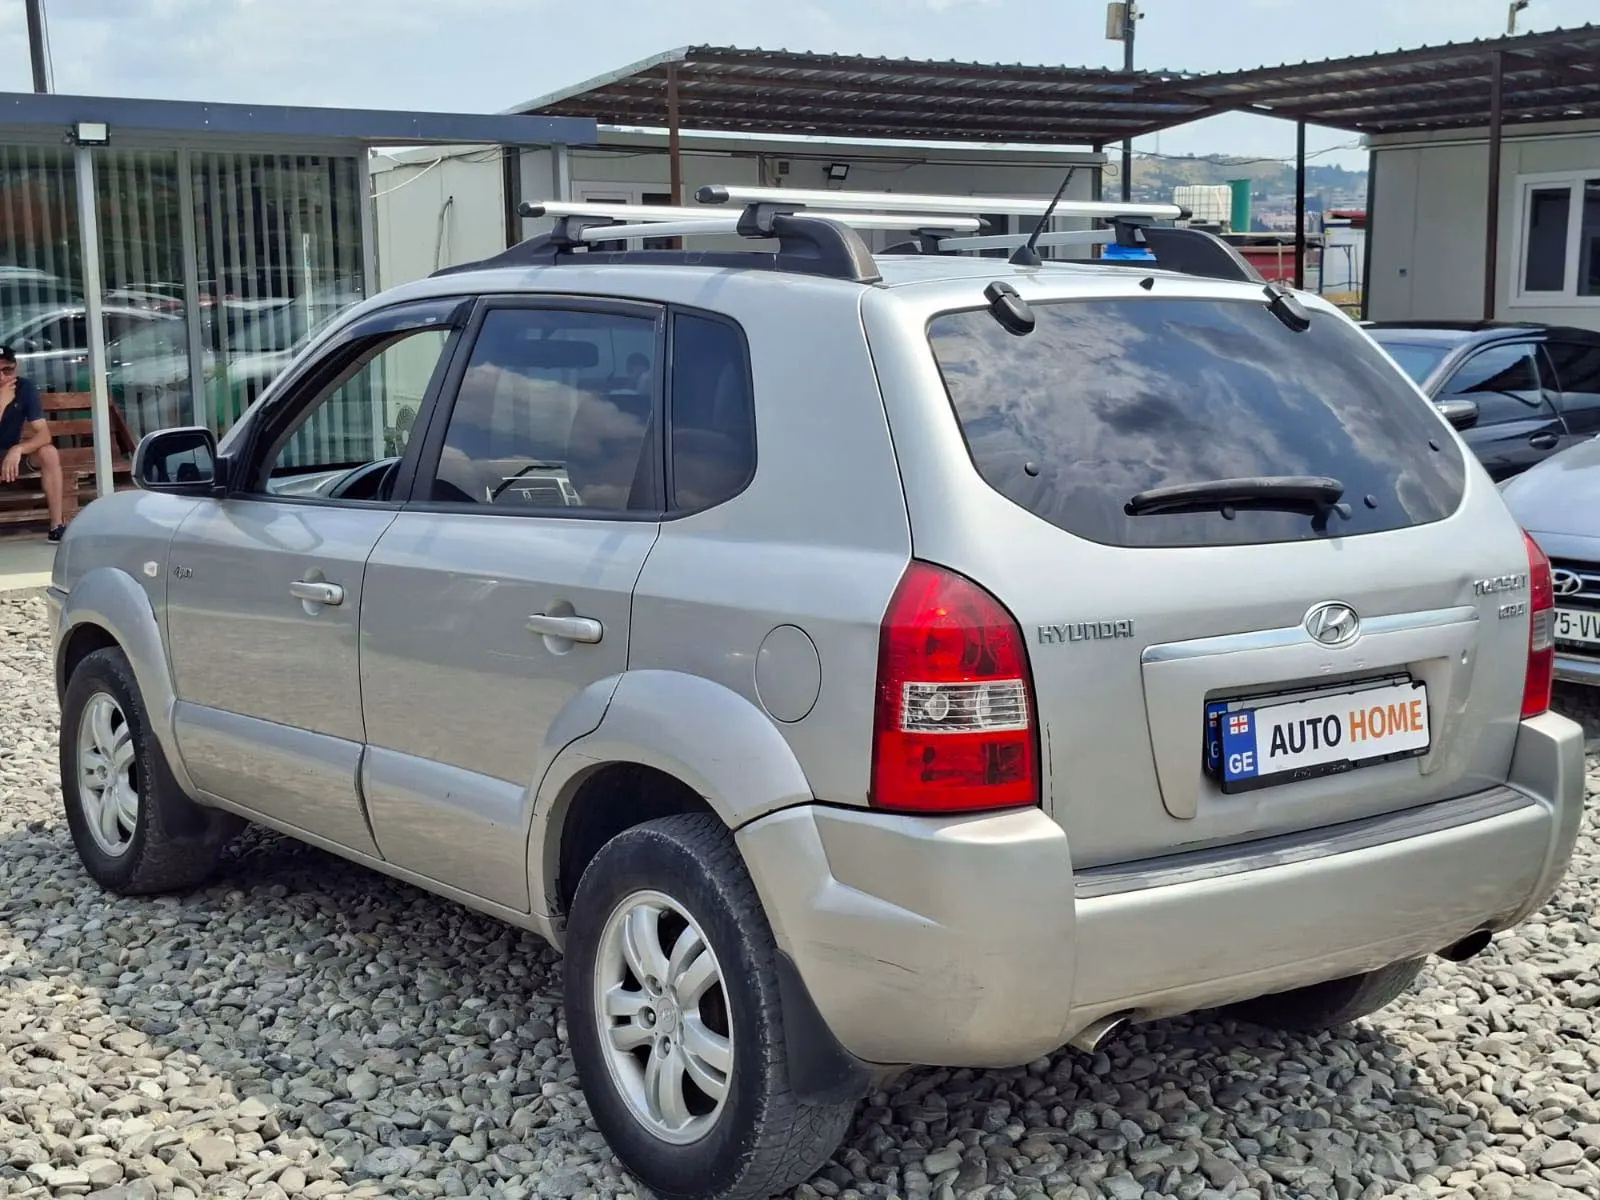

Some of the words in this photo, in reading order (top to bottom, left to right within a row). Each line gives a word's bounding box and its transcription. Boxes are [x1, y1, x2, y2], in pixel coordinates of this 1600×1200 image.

[1038, 619, 1135, 643] HYUNDAI
[1270, 714, 1342, 757] AUTO
[1350, 700, 1423, 742] HOME
[1229, 751, 1254, 774] GE
